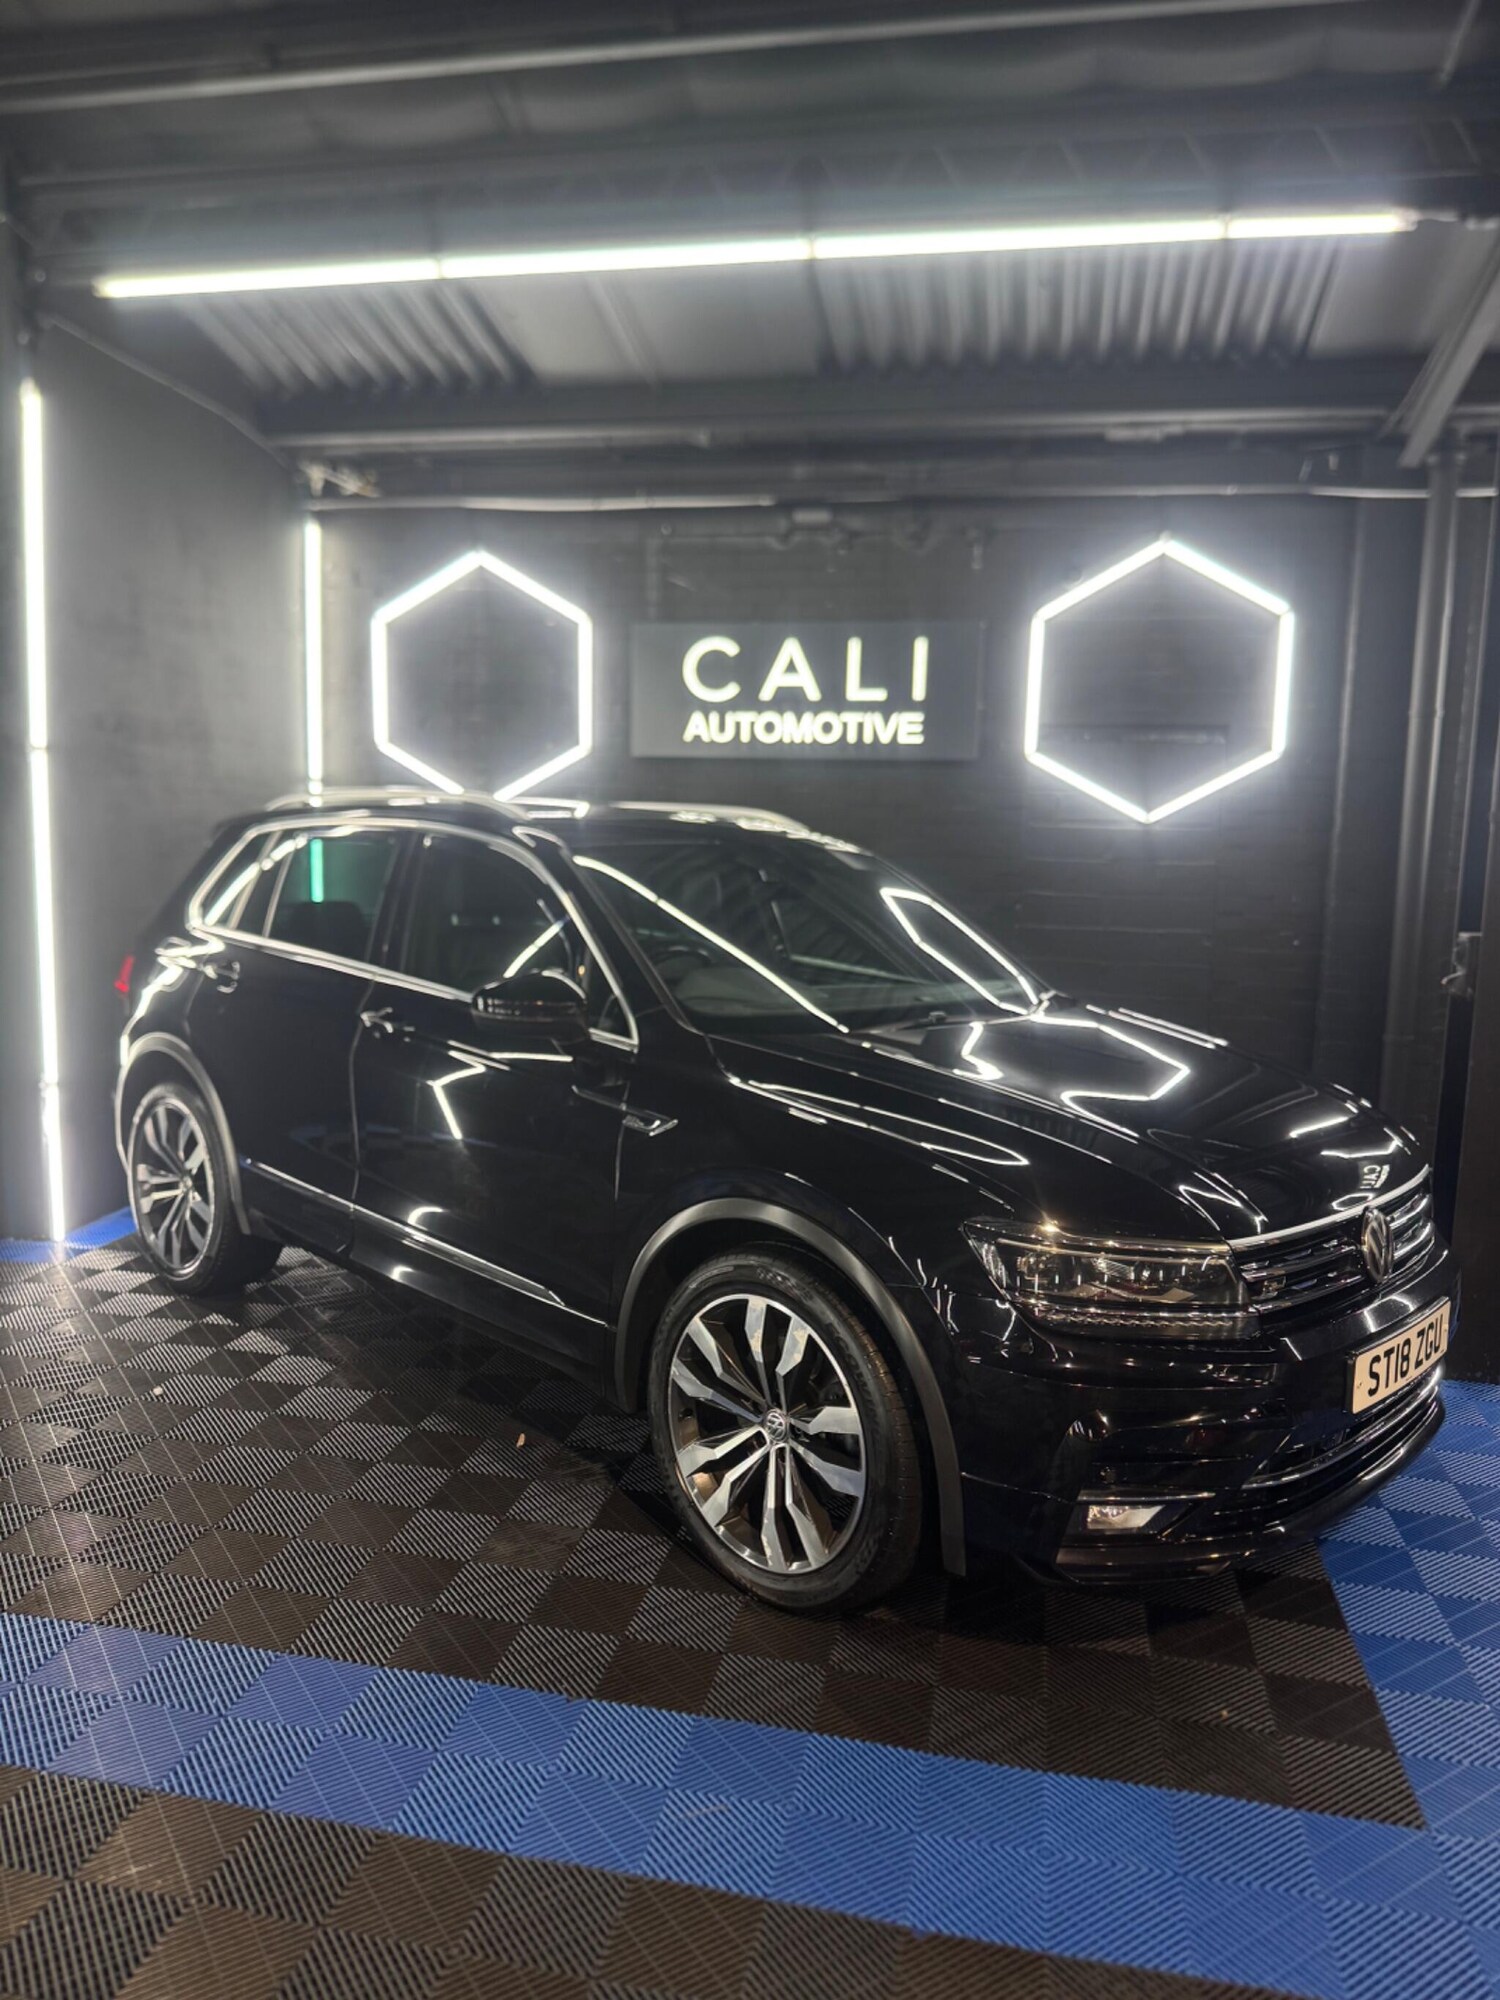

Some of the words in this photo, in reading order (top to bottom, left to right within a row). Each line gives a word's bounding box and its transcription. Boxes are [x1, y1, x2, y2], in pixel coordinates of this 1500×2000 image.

[682, 635, 929, 702] CALI
[682, 710, 925, 745] AUTOMOTIVE
[1368, 1337, 1411, 1397] ST18
[1414, 1313, 1444, 1370] ZGU
